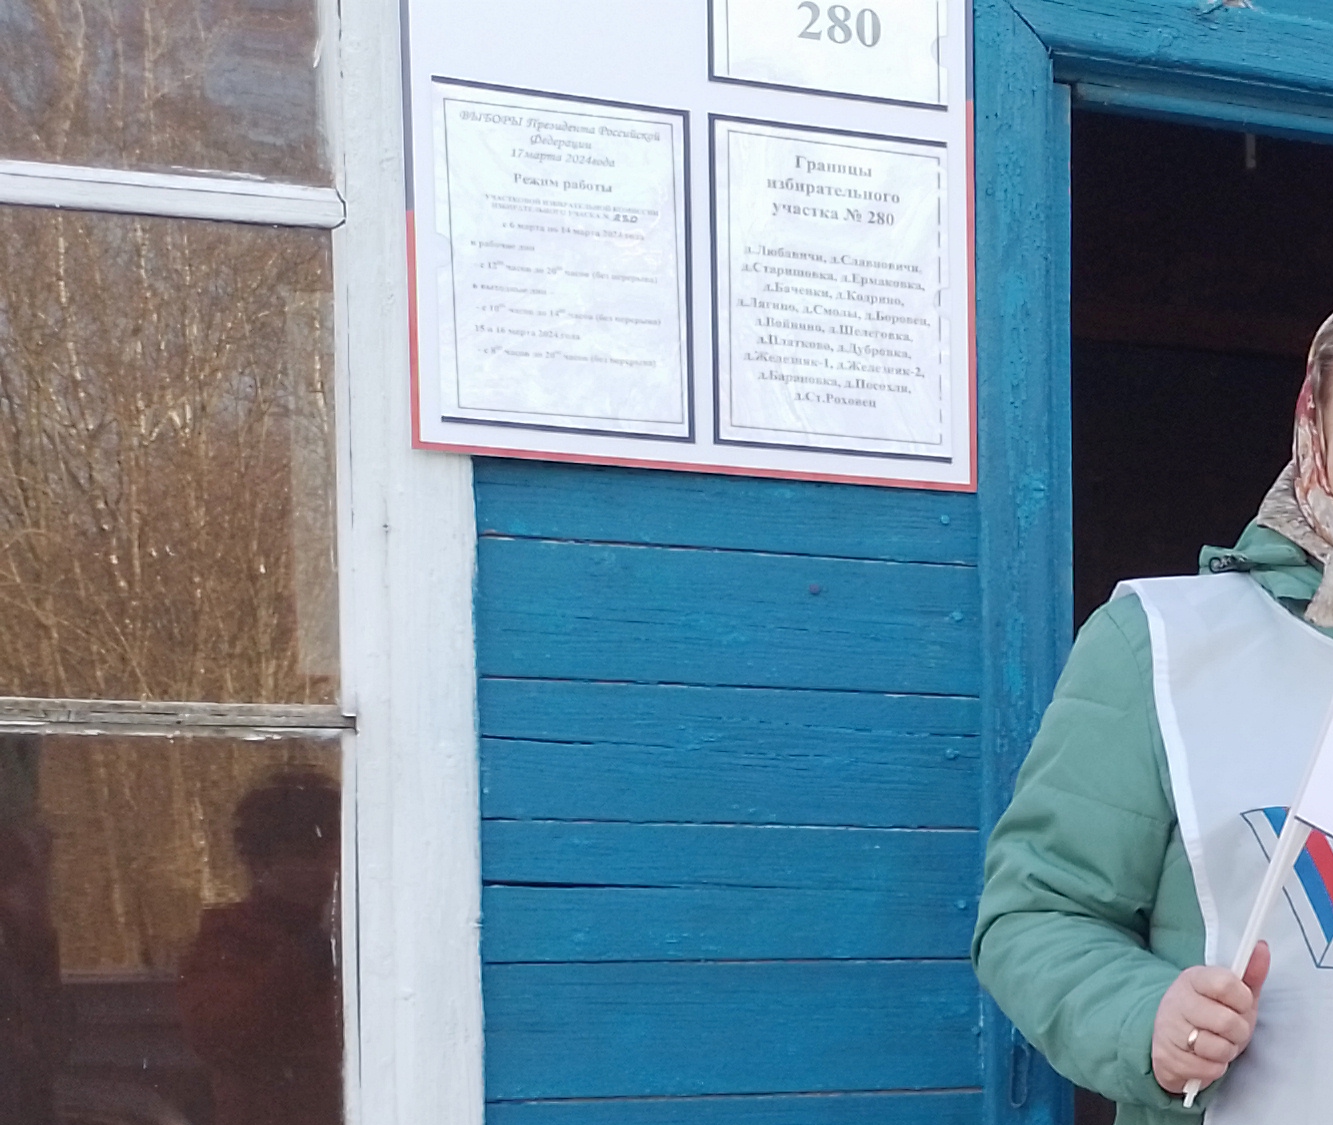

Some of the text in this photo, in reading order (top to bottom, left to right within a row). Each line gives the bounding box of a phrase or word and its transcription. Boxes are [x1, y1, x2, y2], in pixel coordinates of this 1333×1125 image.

[798, 1, 881, 47] 280
[795, 155, 871, 177] Границы
[514, 173, 612, 193] Режим работы
[767, 178, 900, 204] избирательного
[772, 202, 894, 226] участка № 280
